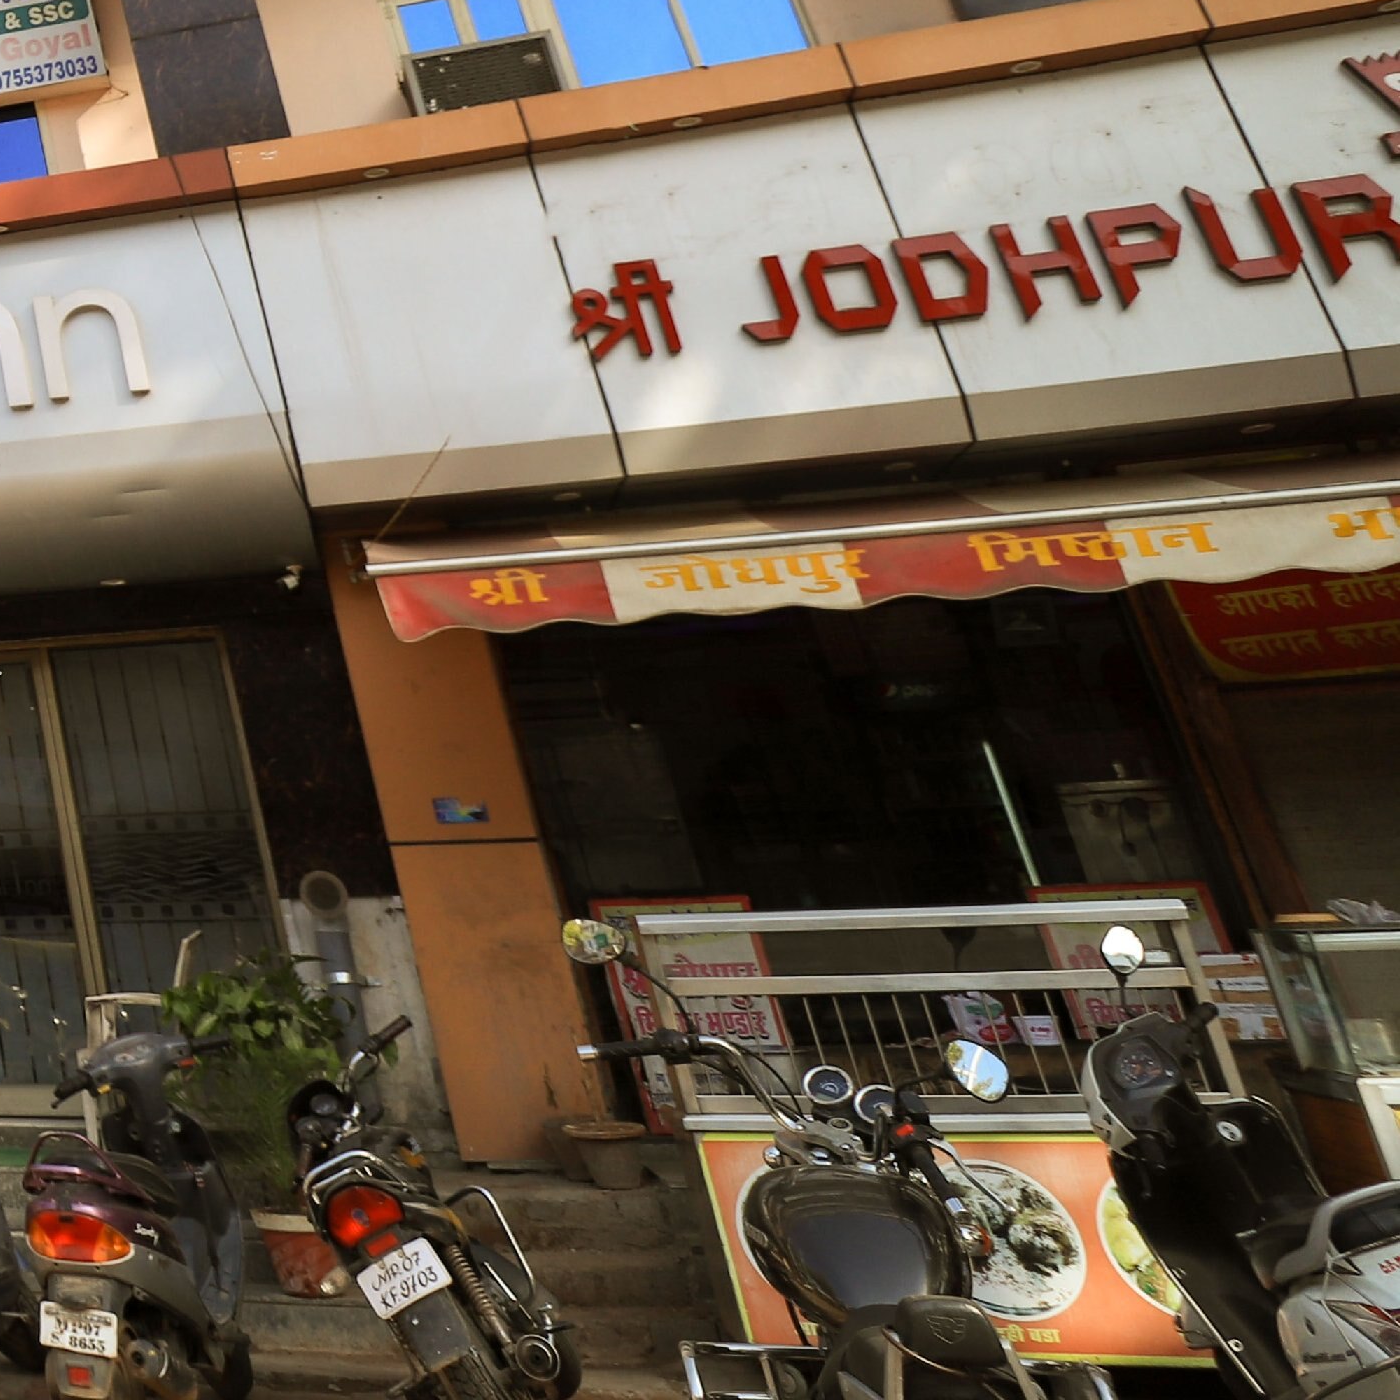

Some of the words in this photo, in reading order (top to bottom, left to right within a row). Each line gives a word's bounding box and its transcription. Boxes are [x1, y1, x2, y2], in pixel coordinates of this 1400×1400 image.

[5, 11, 22, 31] &
[28, 1, 75, 25] SSC
[0, 23, 93, 62] Goyal
[741, 171, 1400, 344] JODHPUR
[572, 258, 682, 360] श्री
[468, 568, 550, 607] श्री
